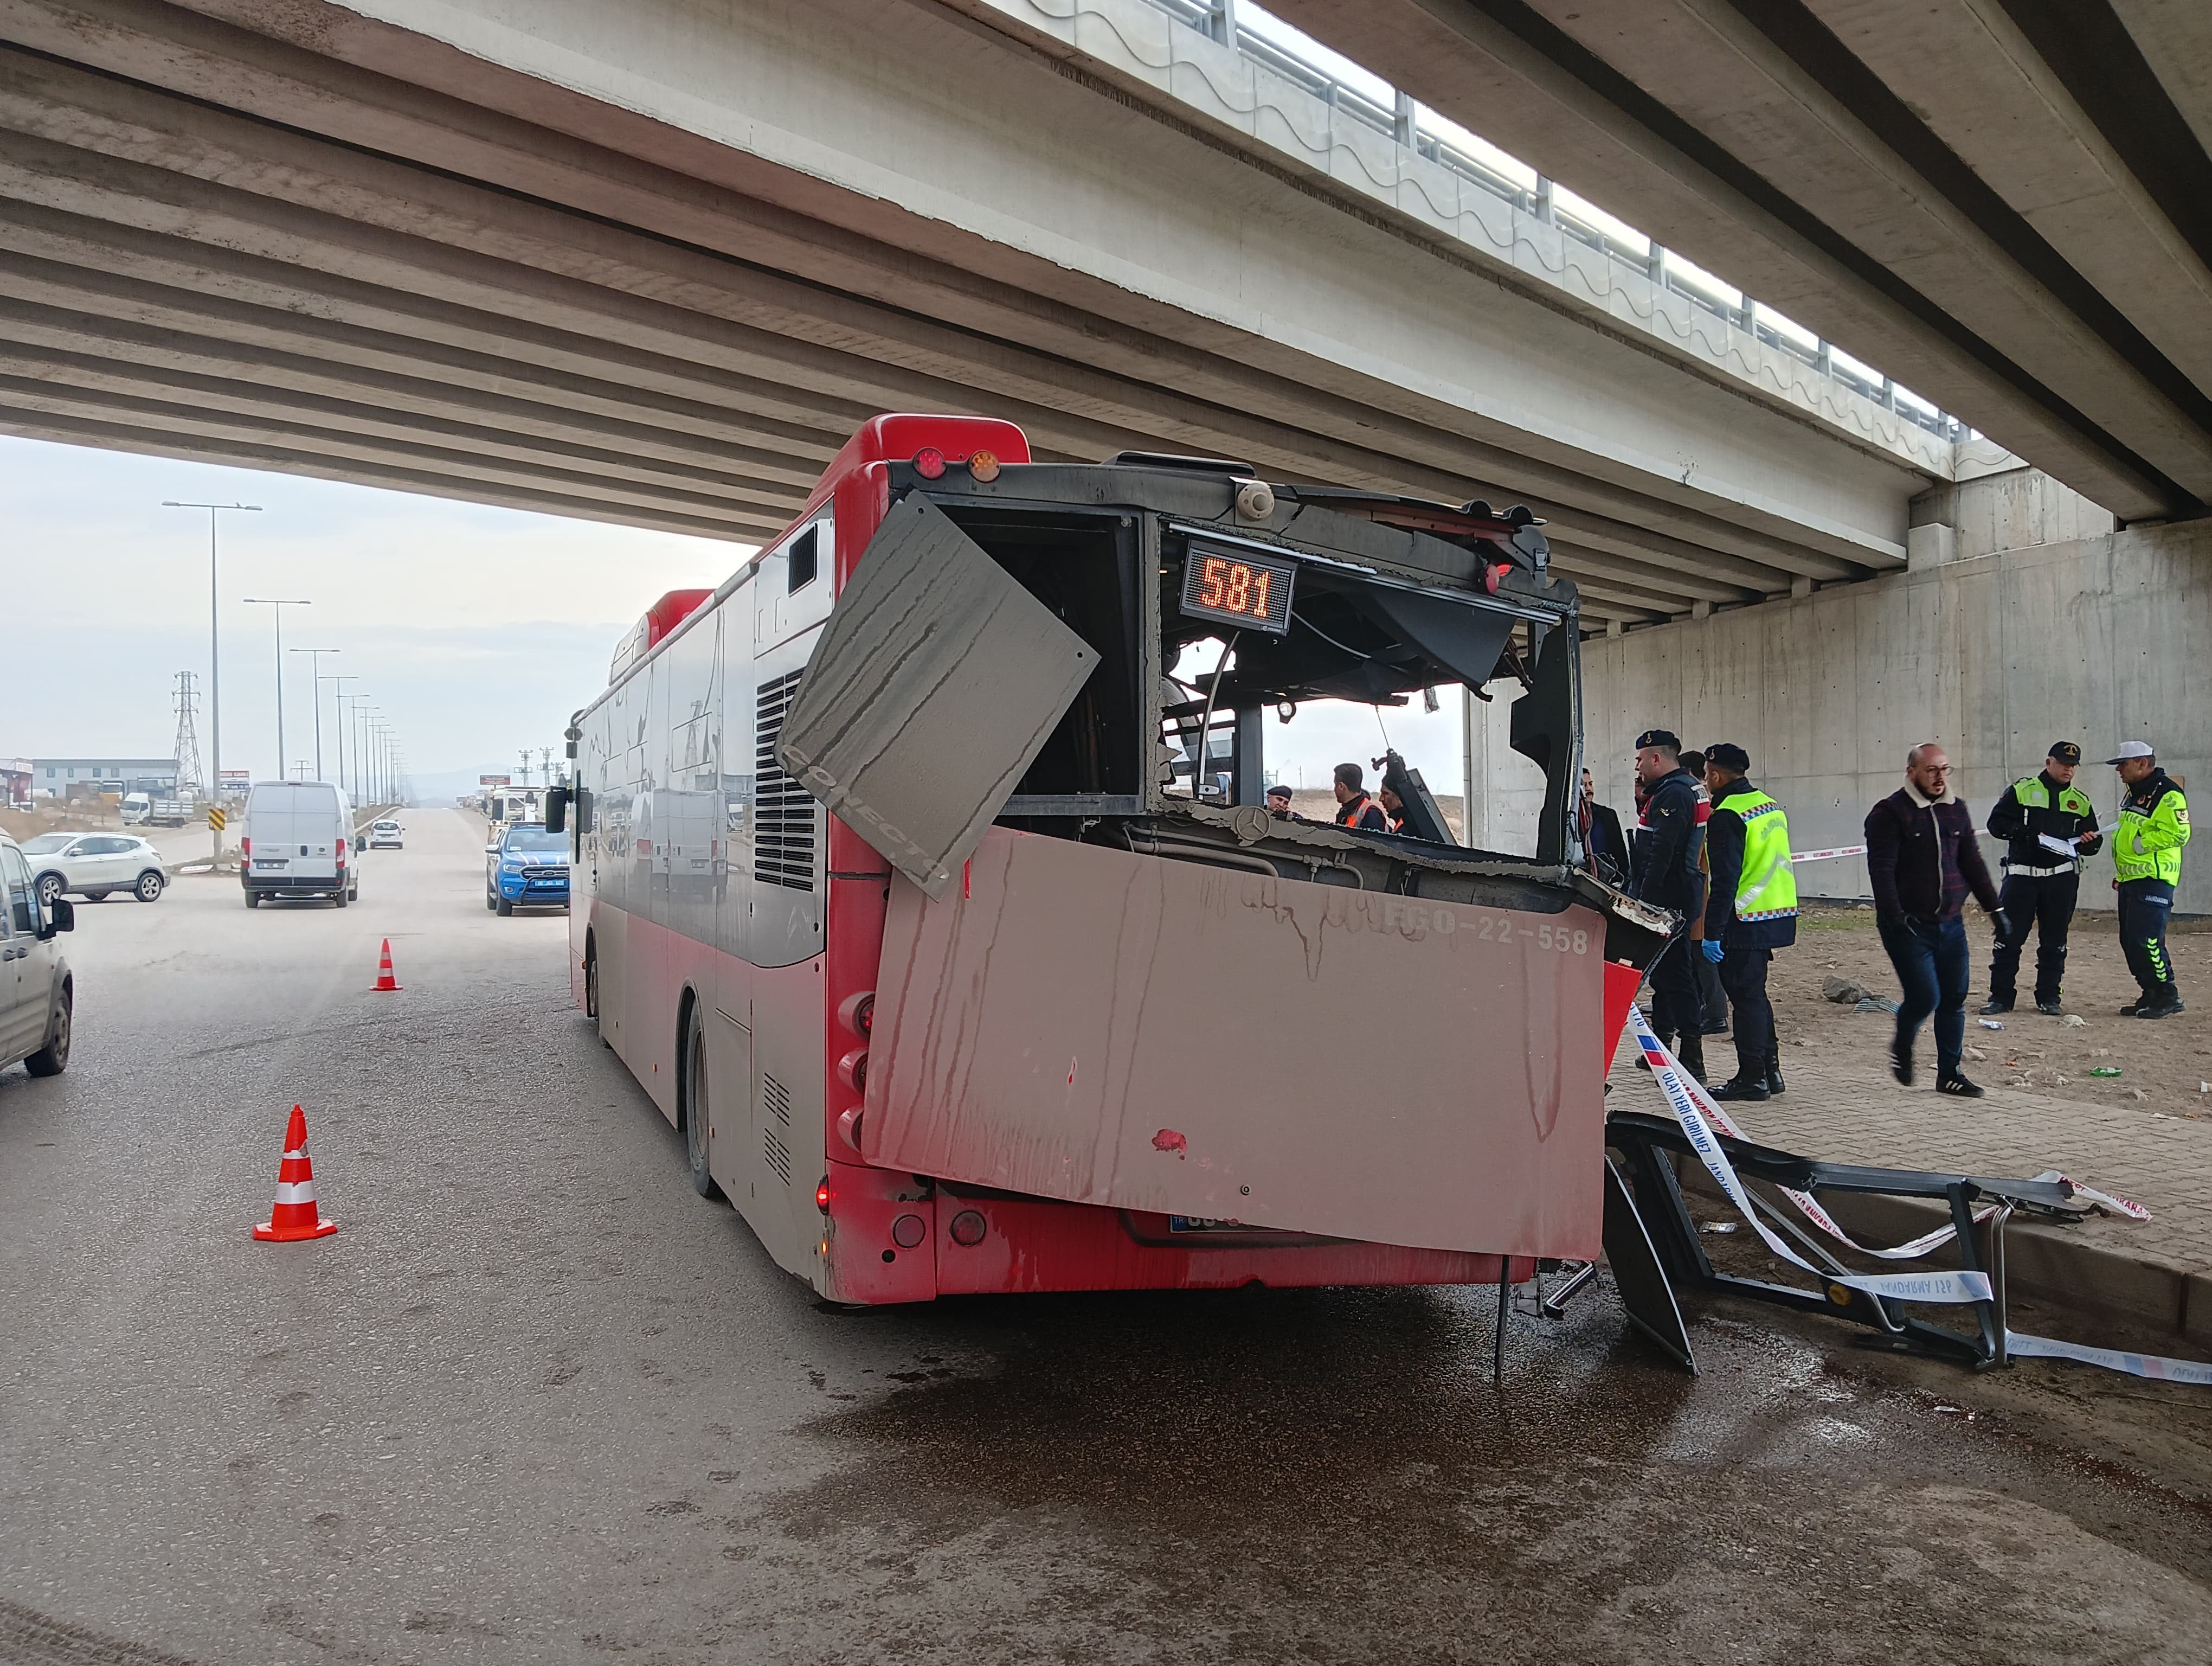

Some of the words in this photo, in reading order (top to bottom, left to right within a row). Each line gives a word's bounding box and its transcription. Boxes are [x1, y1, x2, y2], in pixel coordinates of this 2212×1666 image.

[1201, 558, 1271, 617] 581
[782, 745, 949, 880] CONECTO
[1384, 902, 1587, 954] EGO-22-558
[1662, 1072, 1681, 1094] OLAY
[1682, 1114, 1712, 1154] GİRİLMEZ
